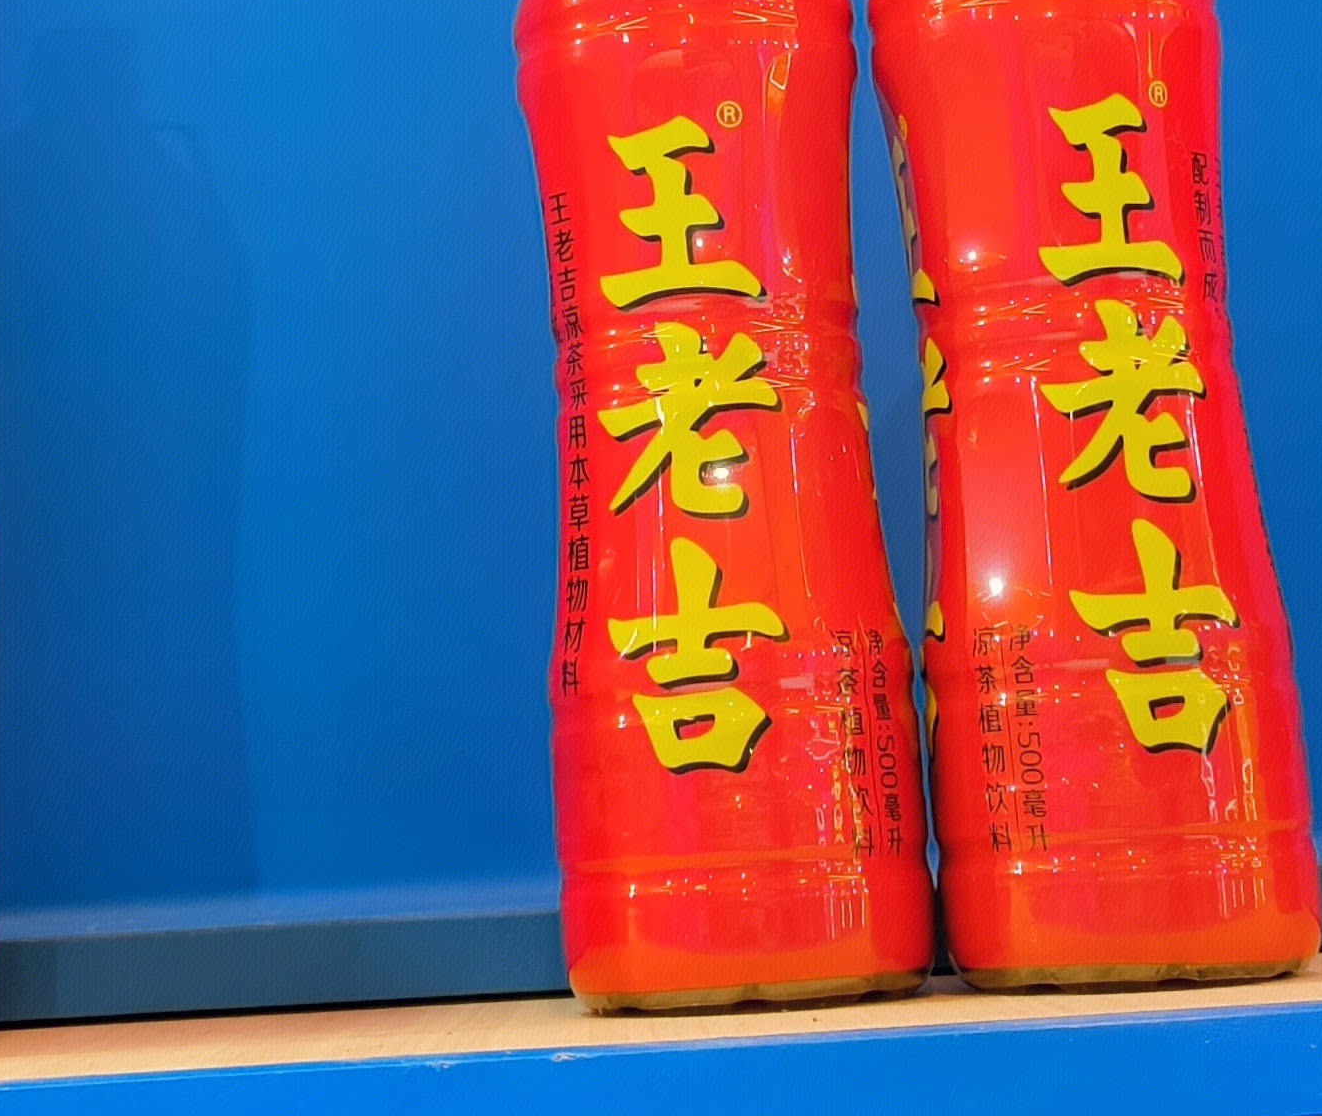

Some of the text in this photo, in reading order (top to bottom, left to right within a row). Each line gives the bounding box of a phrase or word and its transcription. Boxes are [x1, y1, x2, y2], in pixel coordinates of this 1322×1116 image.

[597, 115, 789, 774] 王老吉
[972, 626, 1013, 853] 凉茶植物饮料
[1038, 93, 1241, 754] 王老吉
